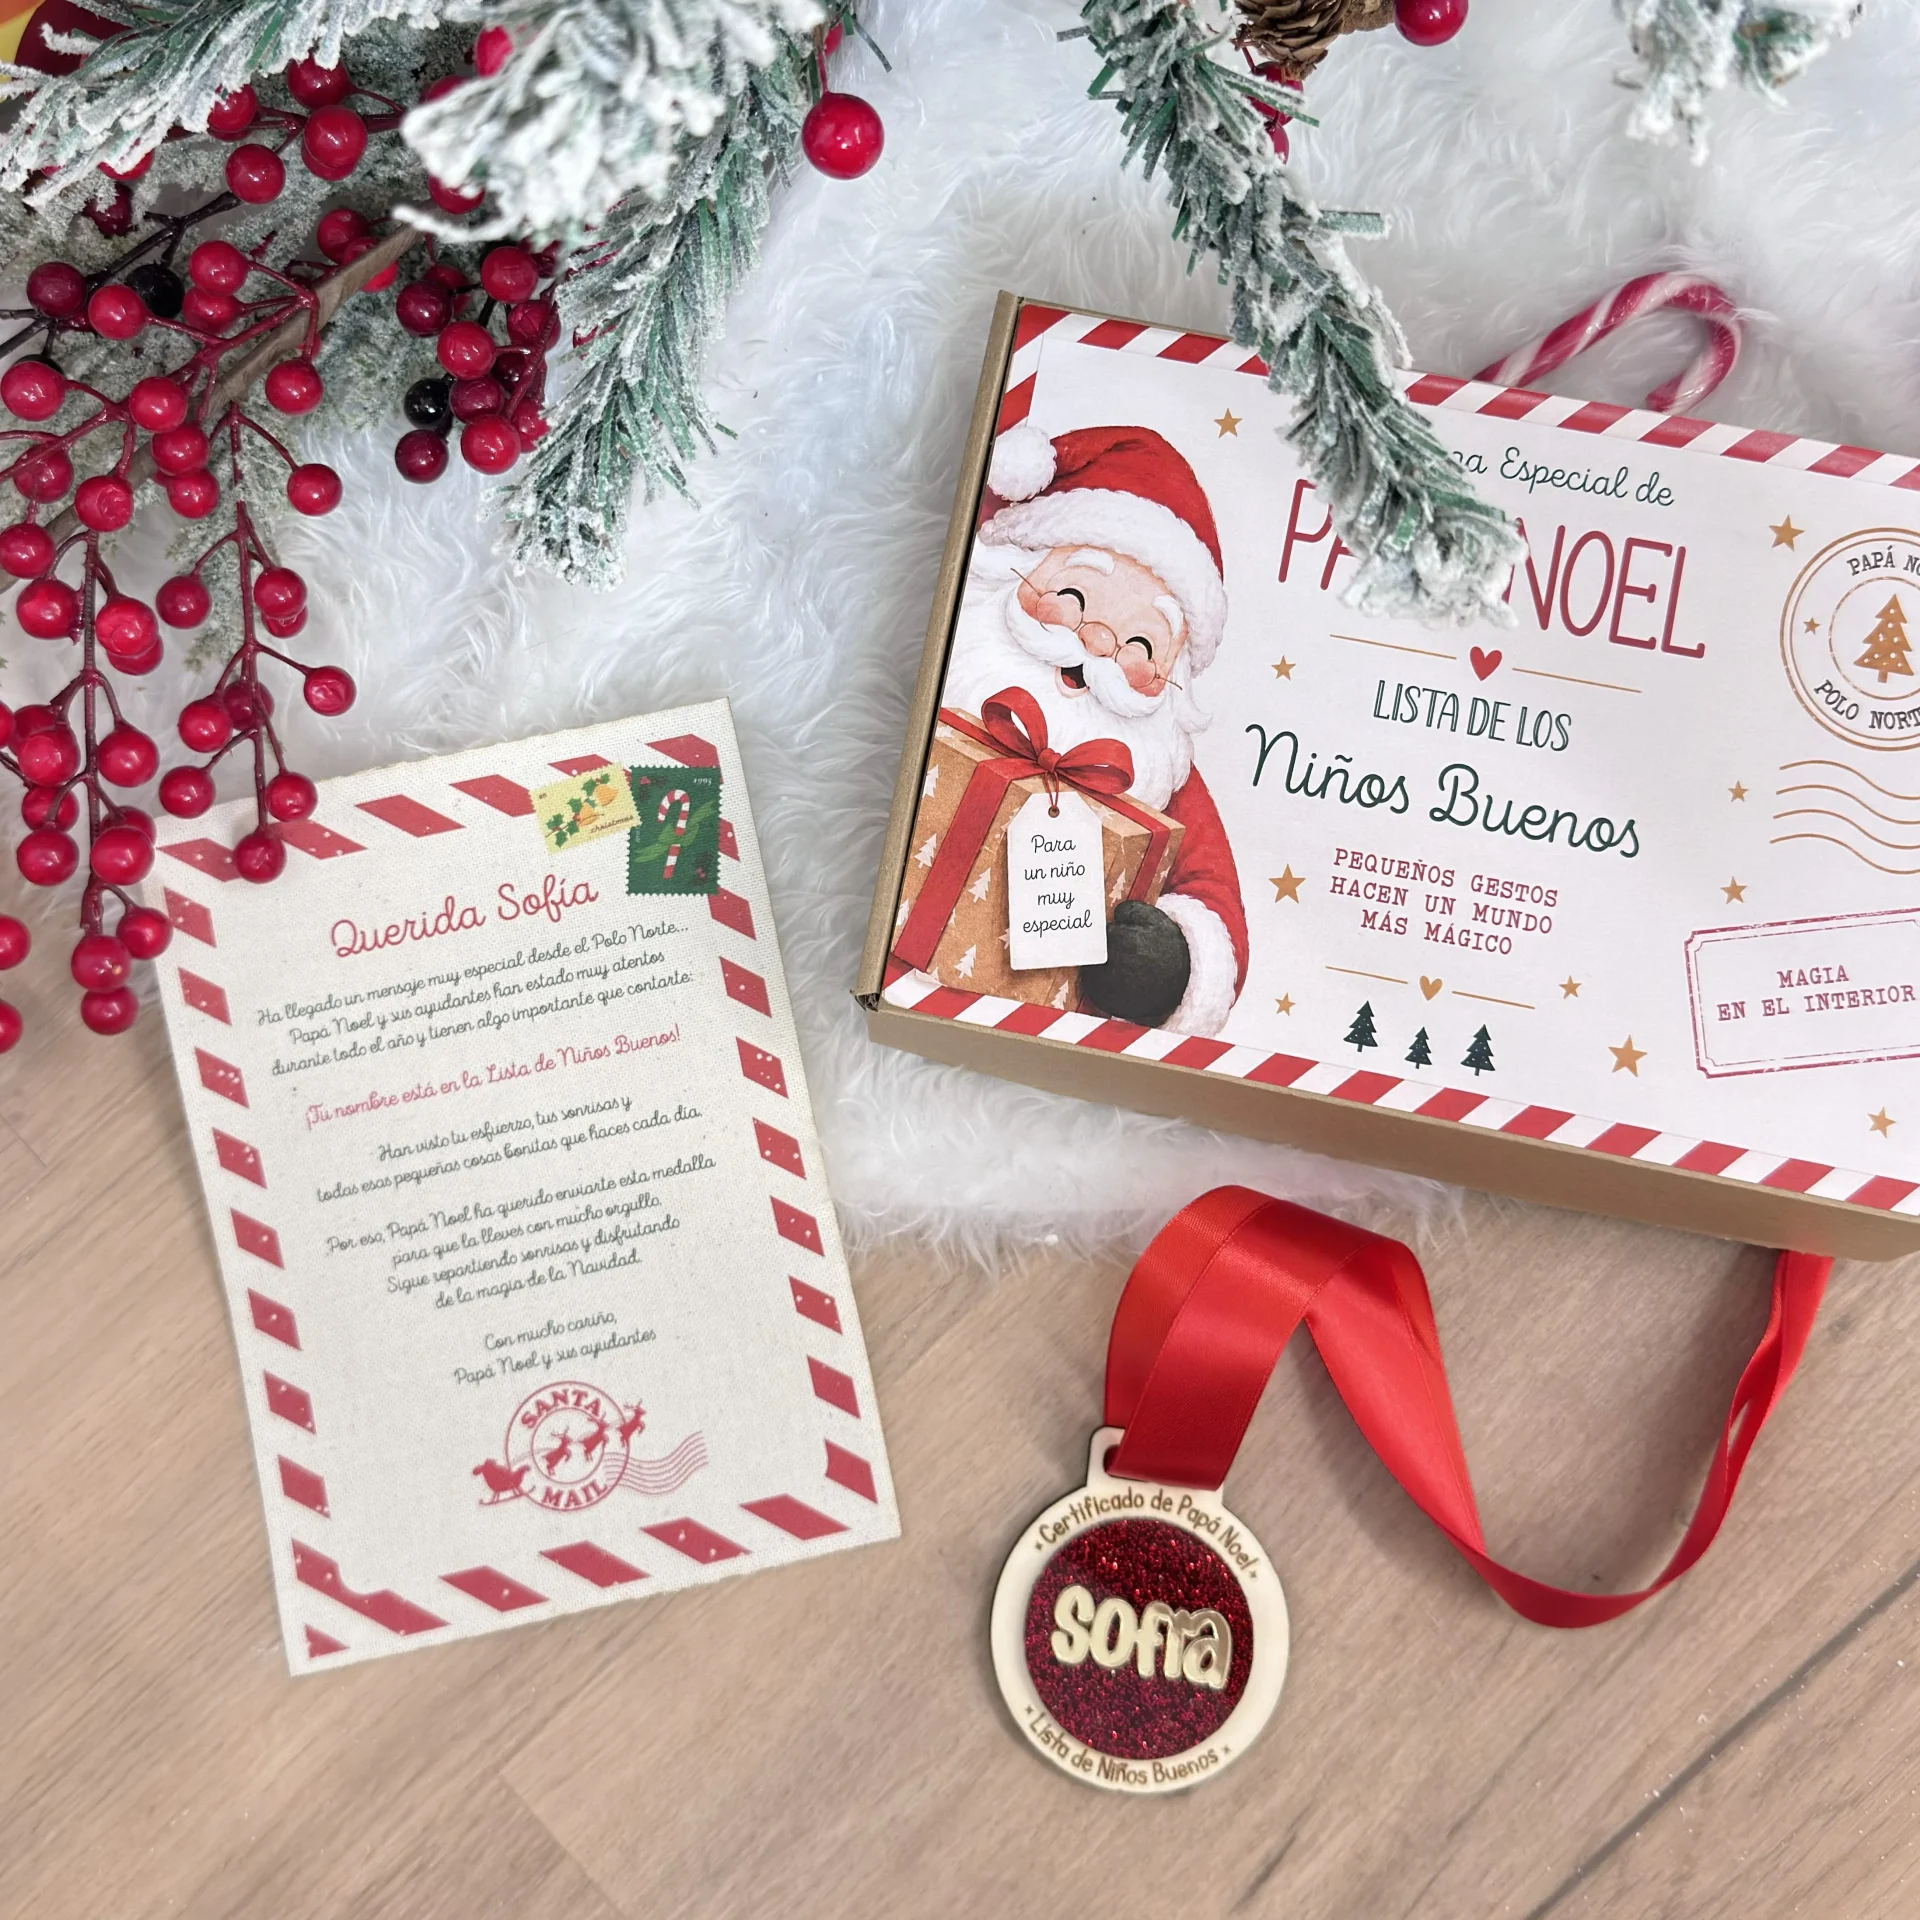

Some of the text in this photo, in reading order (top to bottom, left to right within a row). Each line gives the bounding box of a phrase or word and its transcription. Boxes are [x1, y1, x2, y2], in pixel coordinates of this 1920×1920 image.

[1499, 446, 1629, 499] Especial
[1635, 471, 1675, 506] de
[1505, 516, 1706, 659] NOEL
[1846, 544, 1895, 576] PAPÁ
[1373, 679, 1572, 752] LISTA DE LOS
[1813, 679, 1860, 721] POLO
[1244, 723, 1641, 859] Niños Buenos
[1024, 861, 1086, 882] un niño
[1030, 834, 1077, 854] Para
[1037, 891, 1075, 910] muy
[1329, 876, 1553, 935] HACEN UN MUNDO
[1332, 847, 1559, 908] PEQUEÑOS GESTOS
[331, 875, 598, 957] Querida Sofía
[1023, 909, 1093, 938] especial
[1360, 909, 1513, 955] MÁS MÁGICO
[258, 1009, 283, 1025] Ha
[285, 994, 342, 1019] llegado
[345, 994, 365, 1006] un
[367, 980, 426, 997] mensaje
[428, 972, 461, 986] muy
[464, 951, 525, 980] especial
[528, 942, 571, 964] desde
[574, 937, 590, 954] el
[591, 930, 627, 949] Polo
[289, 951, 665, 1045] Papá Noel y sus ayudantes han estado muy atentos
[1716, 984, 1916, 1021] EN EL INTERIOR
[1776, 964, 1850, 989] MAGIA
[272, 1053, 331, 1076] durante
[333, 1041, 366, 1061] todo
[370, 1036, 385, 1053] el
[387, 1034, 414, 1049] año
[417, 1033, 426, 1047] y
[429, 1022, 474, 1039] tienen
[477, 1011, 510, 1030] algo
[512, 992, 594, 1022] importante
[597, 988, 624, 1006] que
[335, 1091, 399, 1117] nombre
[402, 1083, 437, 1102] está
[440, 1081, 460, 1094] en
[462, 1071, 482, 1089] la
[486, 1062, 531, 1083] Lista
[535, 1053, 556, 1072] de
[557, 1045, 611, 1066] Niños
[614, 1023, 680, 1055] Buenos!
[317, 1182, 359, 1202] todas
[362, 1177, 392, 1192] esas
[394, 1161, 460, 1189] pequeñas
[463, 1152, 502, 1169] cosas
[504, 1139, 557, 1159] bonitas
[560, 1133, 587, 1151] que
[588, 1123, 630, 1140] haces
[632, 1110, 671, 1131] cada
[378, 1097, 632, 1161] Han visto tu esfuerzo, tus sonrisas y
[327, 1236, 357, 1252] Por
[386, 1220, 429, 1238] Papá
[429, 1206, 472, 1227] Noel
[474, 1203, 495, 1218] ha
[497, 1188, 553, 1218] querido
[555, 1177, 616, 1201] enviarte
[619, 1170, 650, 1187] esta
[652, 1154, 716, 1179] medalla
[388, 1214, 680, 1294] Sigue repartiendo sonrisas y disfrutando
[393, 1249, 430, 1269] para
[433, 1242, 460, 1259] que
[461, 1233, 479, 1248] la
[481, 1226, 524, 1244] lleves
[526, 1220, 554, 1233] con
[556, 1205, 603, 1227] mucho
[436, 1292, 454, 1308] de
[456, 1288, 474, 1303] la
[477, 1280, 525, 1298] magia
[526, 1270, 546, 1287] de
[548, 1266, 566, 1282] la
[454, 1329, 656, 1385] Papá Noel y sus ayudantes
[485, 1334, 515, 1350] Con
[517, 1320, 565, 1342] mucho
[521, 1388, 602, 1430] SANTA
[541, 1478, 608, 1508] MAIL
[1038, 1485, 1260, 1571] Certificado de Papá Noel
[1029, 1711, 1219, 1785] Lista de Niños Buenos
